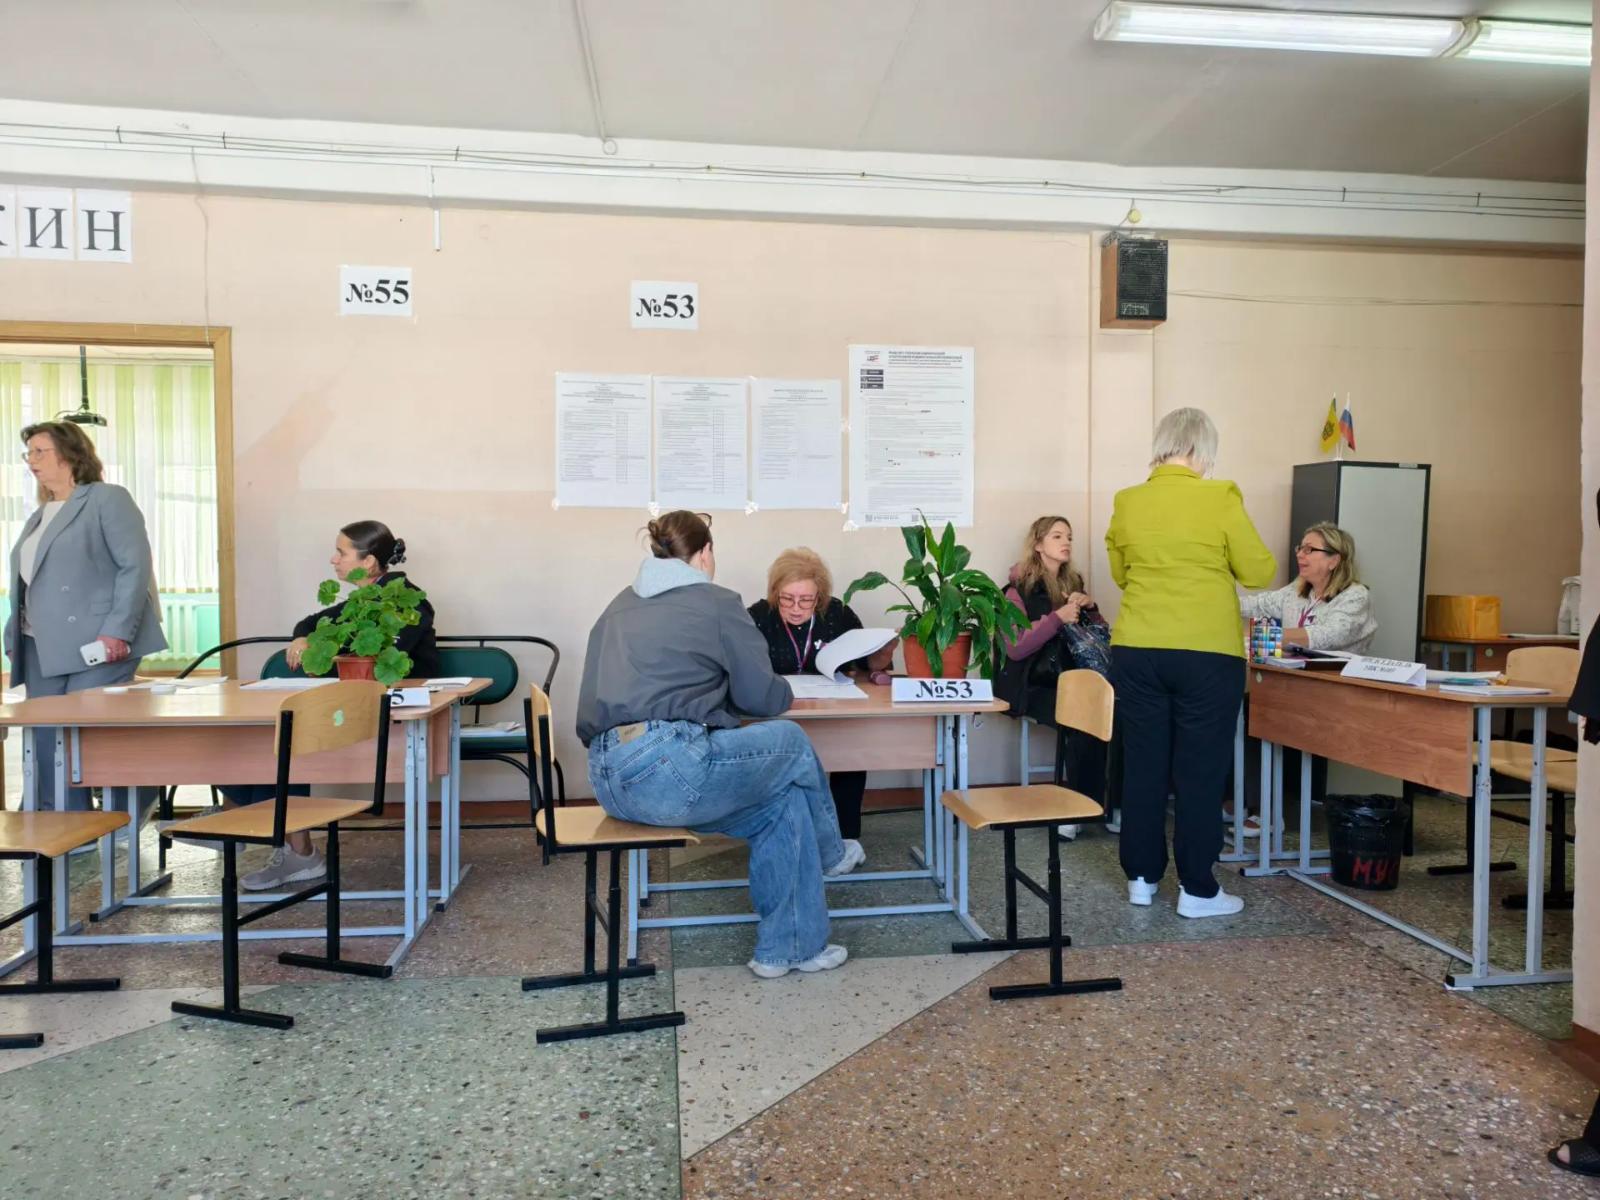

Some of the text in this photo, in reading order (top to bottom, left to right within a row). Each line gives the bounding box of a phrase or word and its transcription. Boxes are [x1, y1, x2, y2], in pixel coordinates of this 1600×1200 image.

[345, 279, 409, 305] №55
[635, 293, 695, 319] №53
[915, 680, 973, 699] №53
